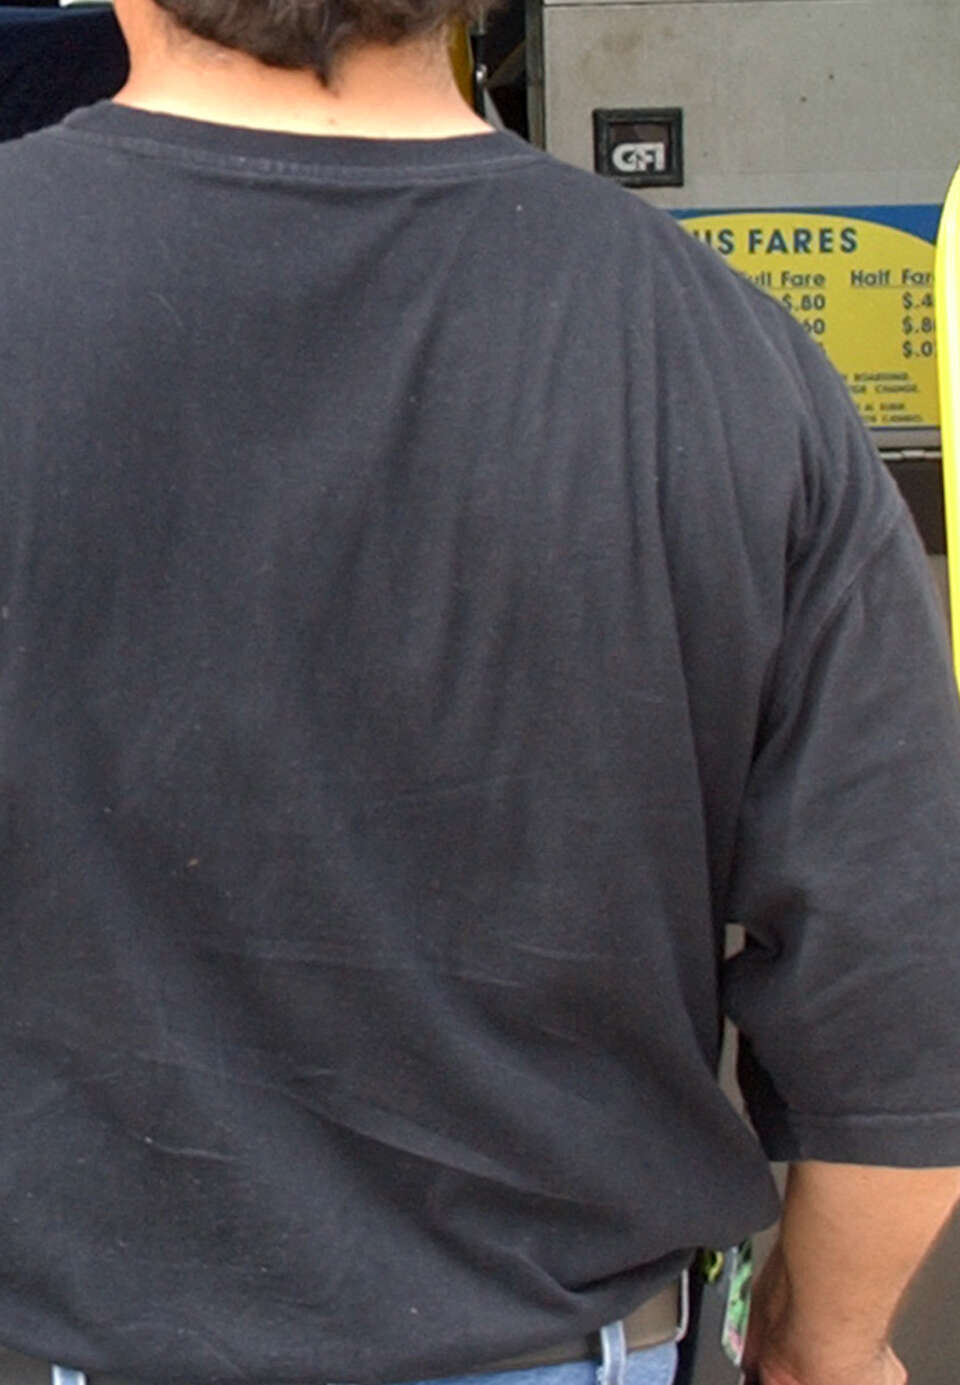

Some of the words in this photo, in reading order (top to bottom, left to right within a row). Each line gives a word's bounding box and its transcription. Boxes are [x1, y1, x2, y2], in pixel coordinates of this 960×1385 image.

[749, 227, 857, 254] FARES
[781, 271, 825, 286] Fare
[851, 269, 889, 286] Half
